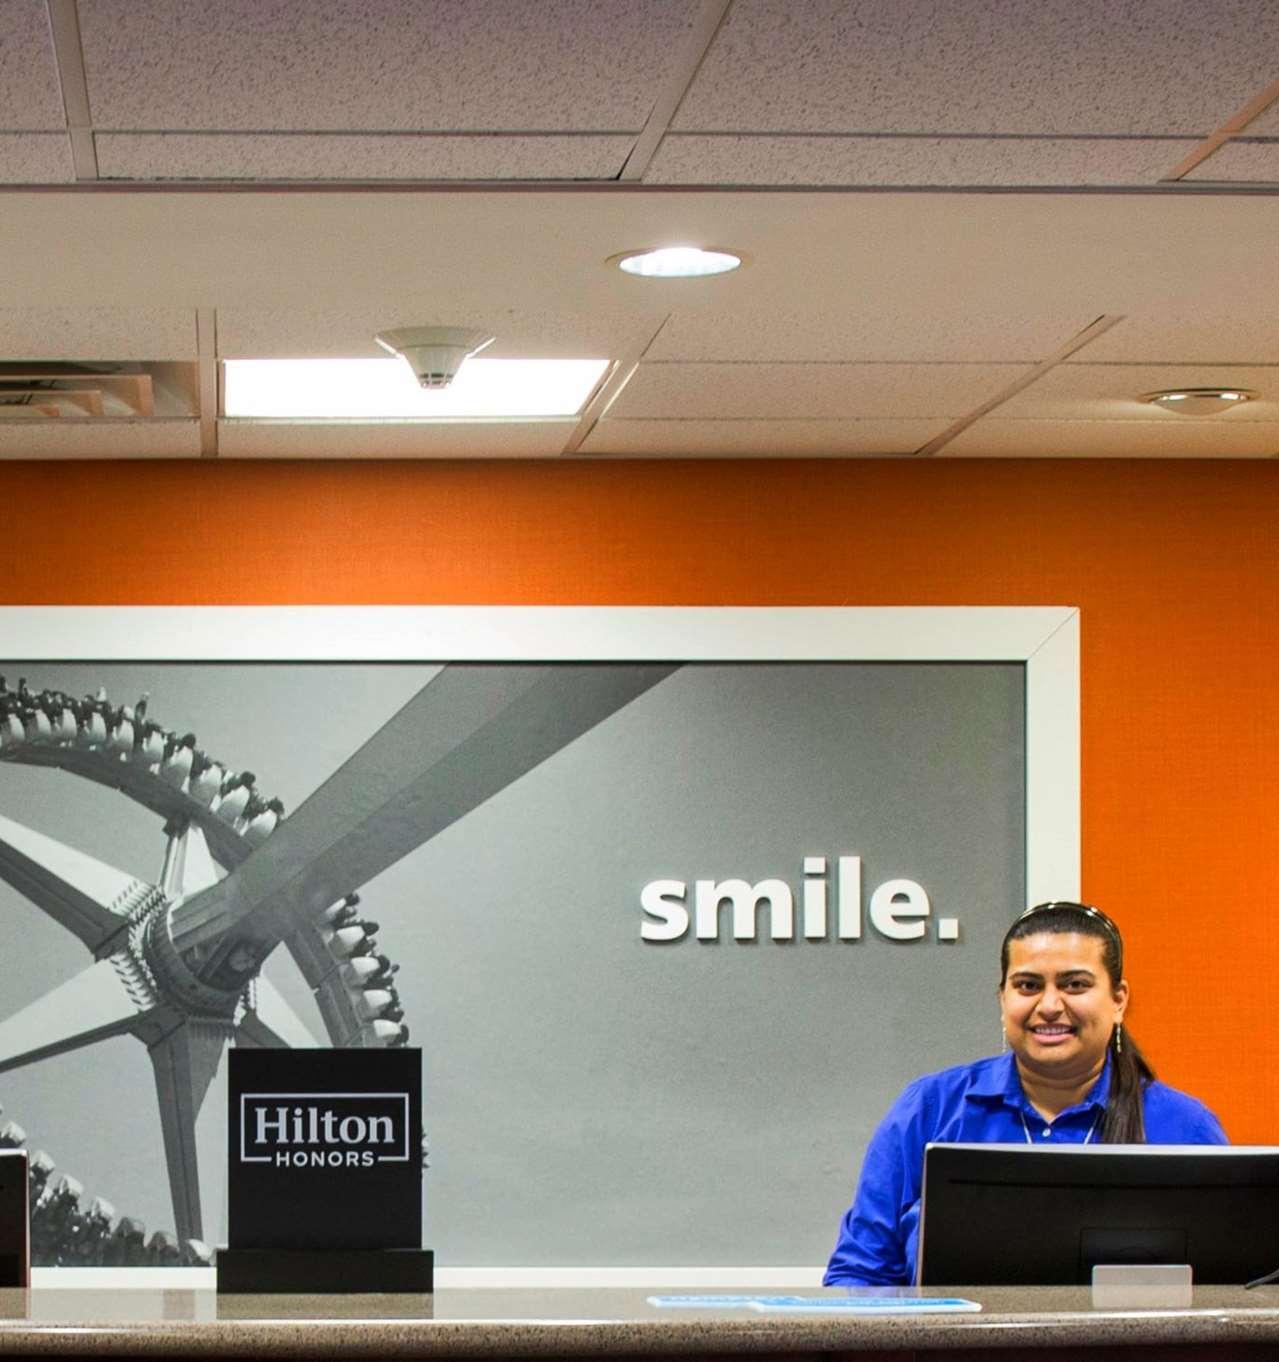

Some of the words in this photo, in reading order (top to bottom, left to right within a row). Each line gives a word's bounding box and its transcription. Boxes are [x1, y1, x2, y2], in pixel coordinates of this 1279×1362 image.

[639, 856, 959, 941] smile.
[254, 1107, 395, 1144] Hilton
[276, 1151, 374, 1167] HONORS
